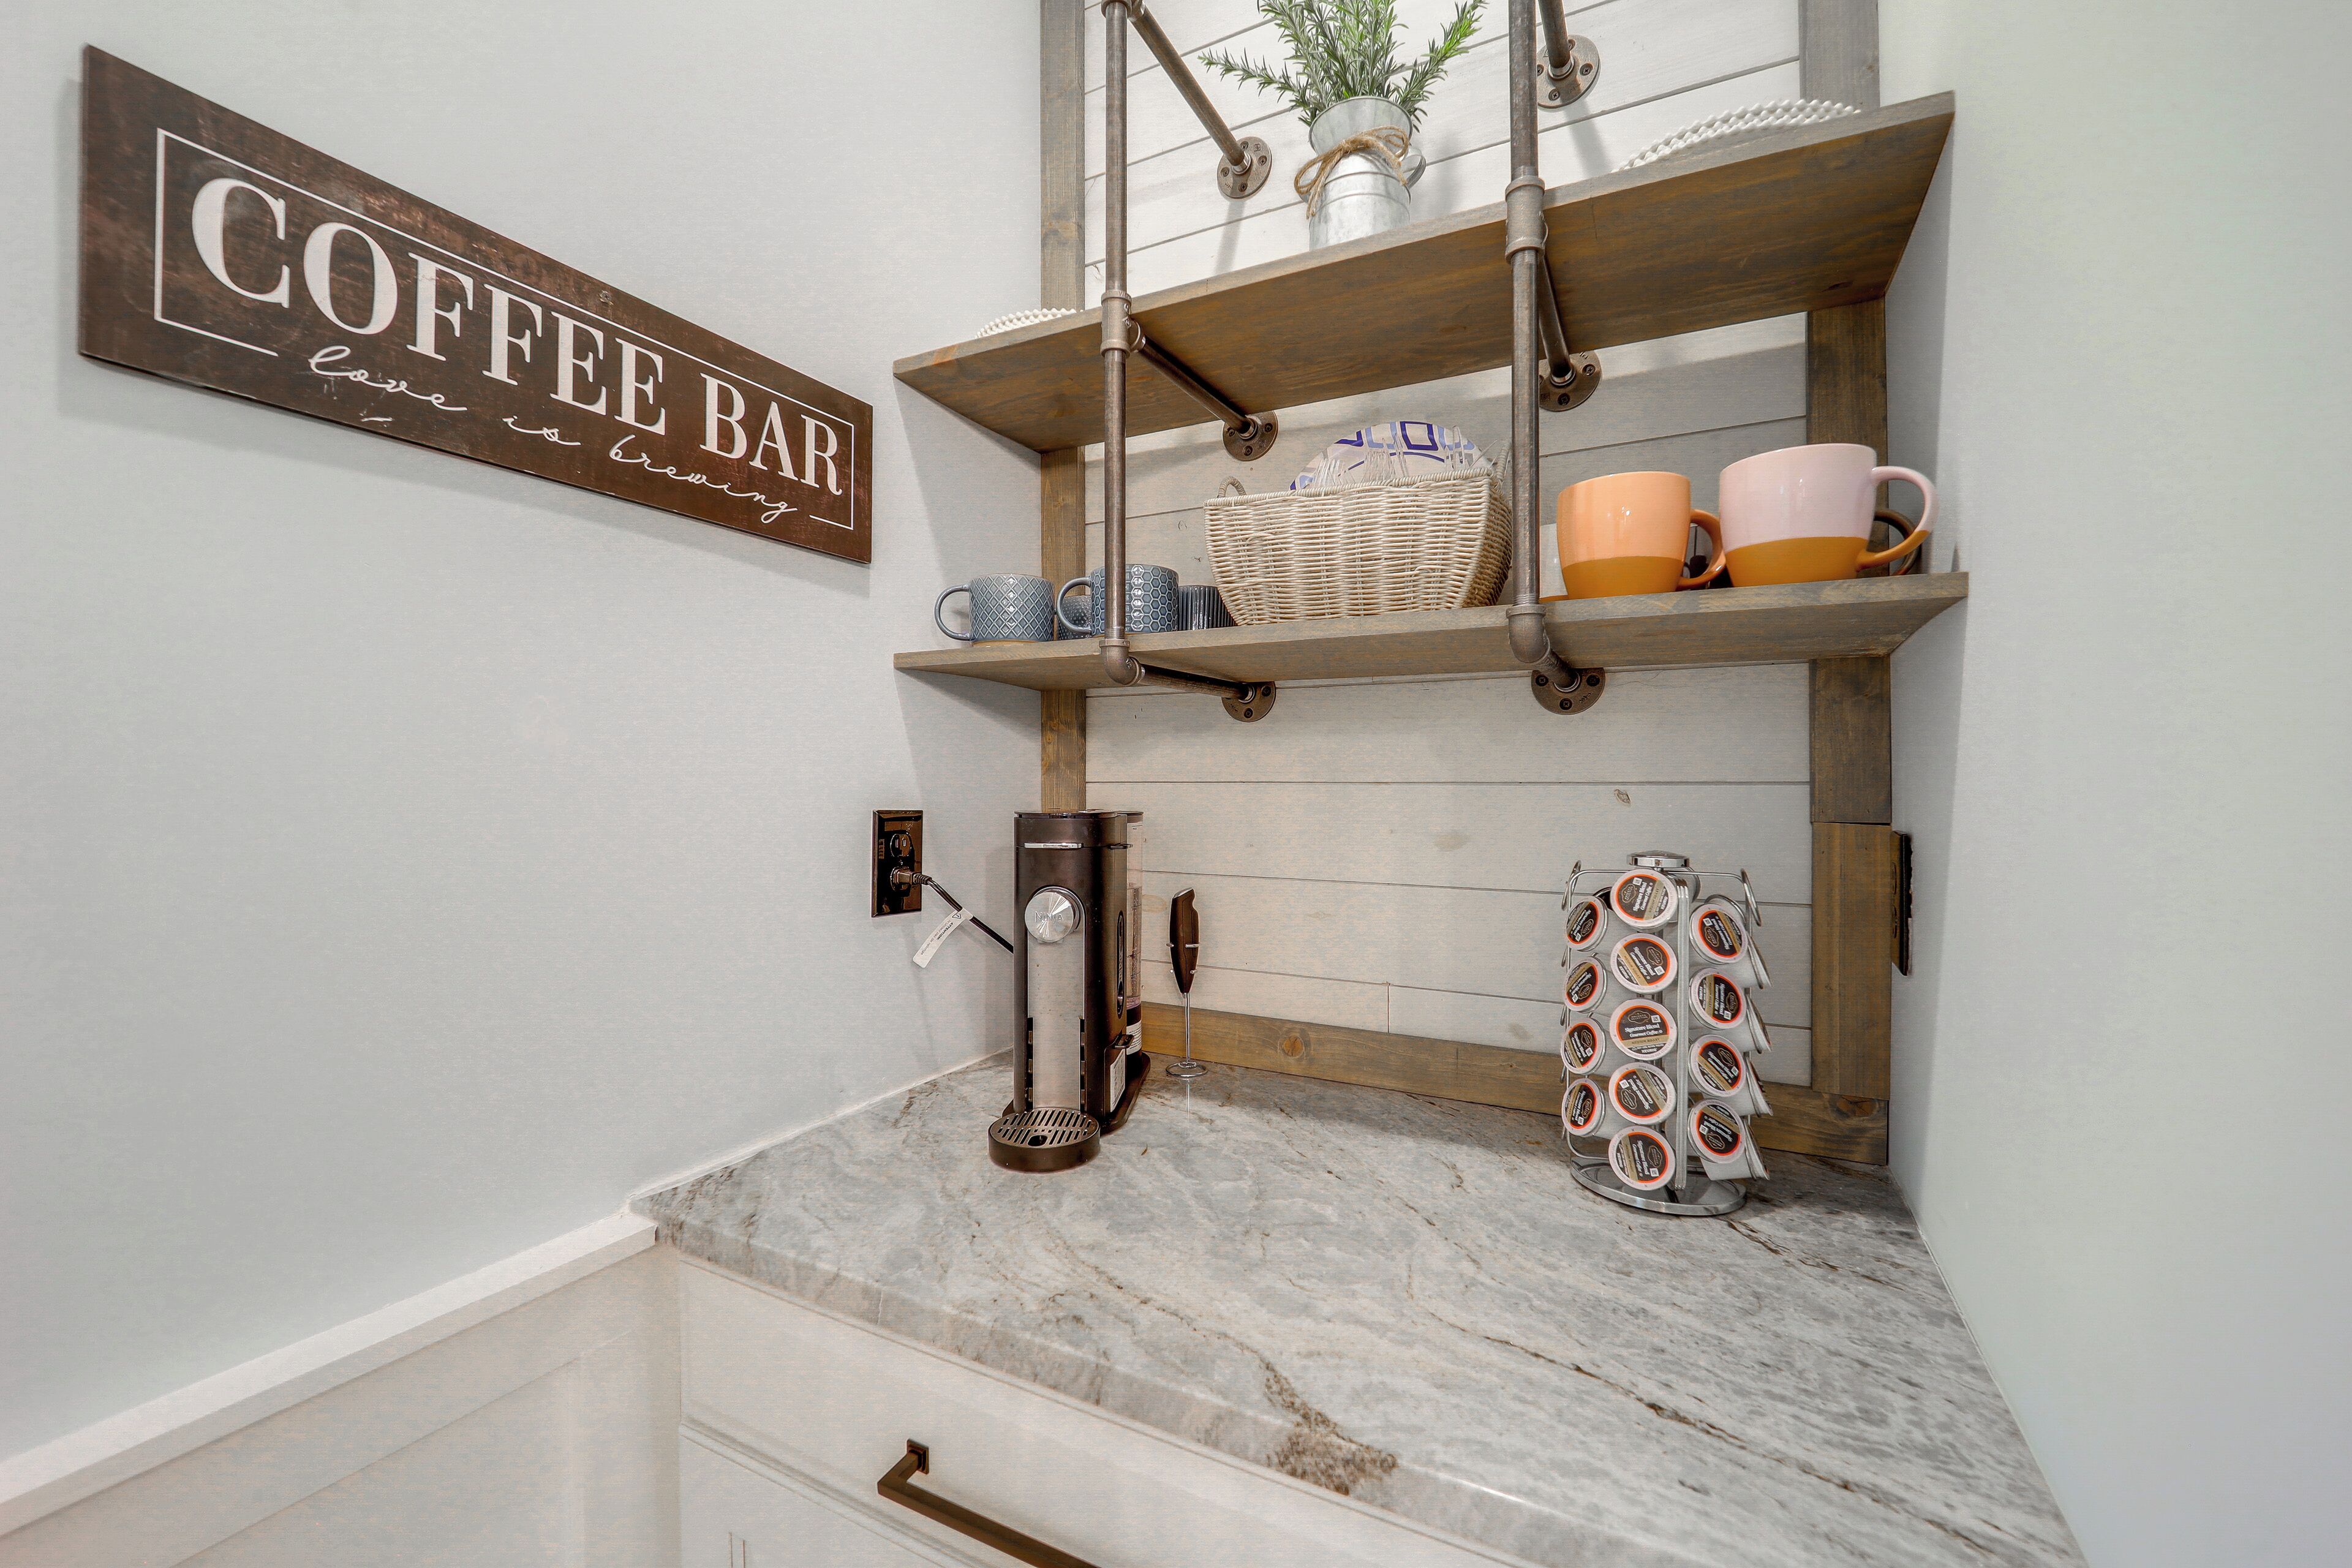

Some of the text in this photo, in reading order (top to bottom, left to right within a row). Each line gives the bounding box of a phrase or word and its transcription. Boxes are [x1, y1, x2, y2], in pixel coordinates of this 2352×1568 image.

[191, 177, 843, 496] COFFEE BAR
[307, 345, 797, 524] love is brewing
[1632, 881, 1647, 912] Signature Blend
[1644, 885, 1653, 896] Coffee
[1035, 911, 1063, 924] NINJA
[935, 921, 954, 941] ATTENTION:
[1632, 945, 1656, 977] Signature Blend
[1638, 964, 1648, 977] Coffee
[1624, 1024, 1646, 1033] Signature
[1627, 1077, 1651, 1110] Signature Blend
[1634, 1077, 1645, 1090] Coffee
[1636, 1139, 1650, 1175] Signature Blend
